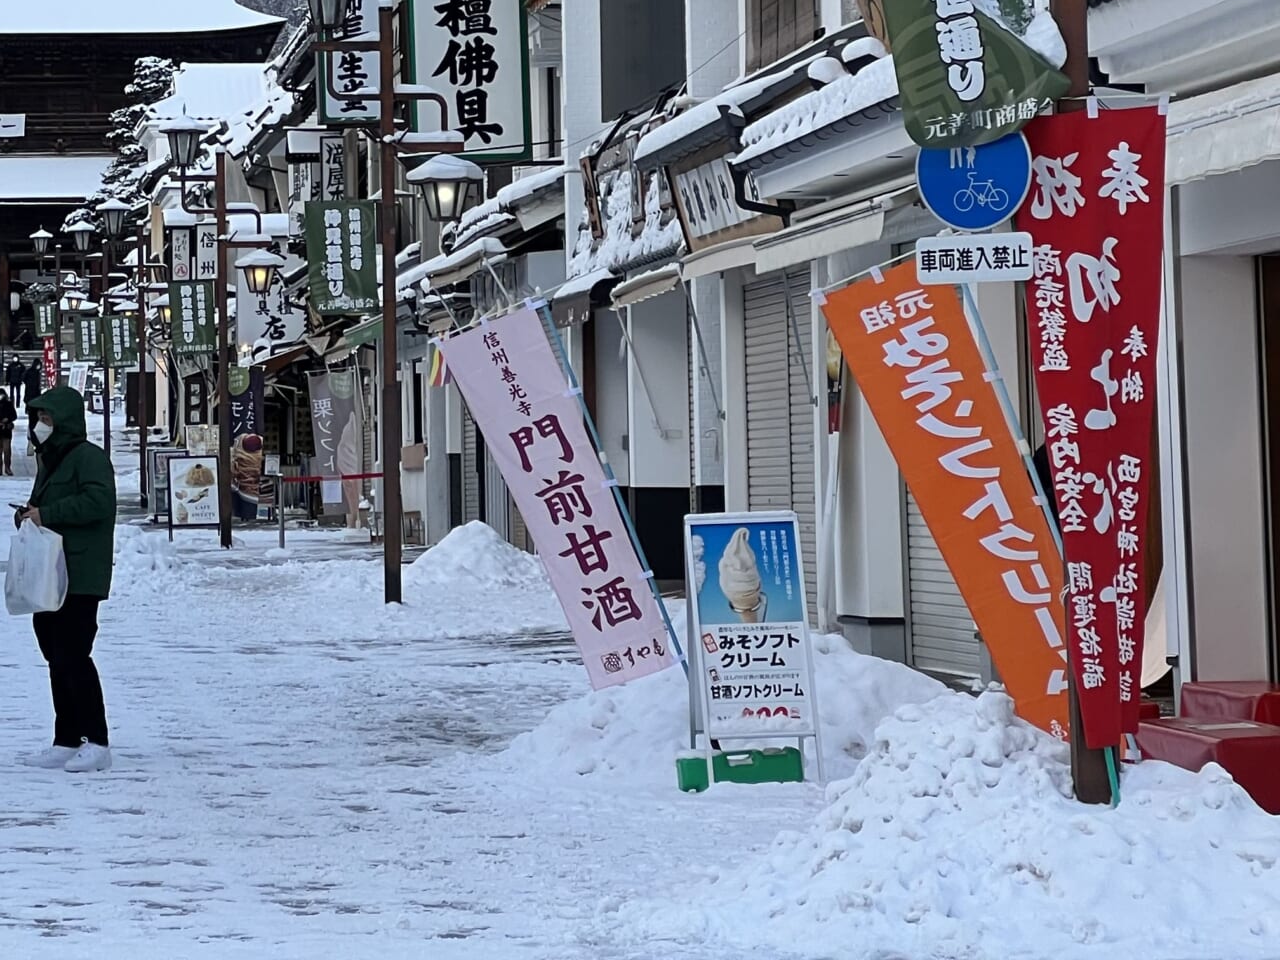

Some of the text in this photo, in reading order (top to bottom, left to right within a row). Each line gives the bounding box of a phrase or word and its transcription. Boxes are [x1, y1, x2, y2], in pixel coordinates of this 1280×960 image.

[920, 244, 1030, 273] 車両進入禁止
[483, 330, 643, 633] 信州善光寺 門前甘酒
[719, 633, 800, 650] みそソフト
[721, 652, 786, 668] クリーム
[710, 683, 805, 700] 甘酒ソフトクリーム
